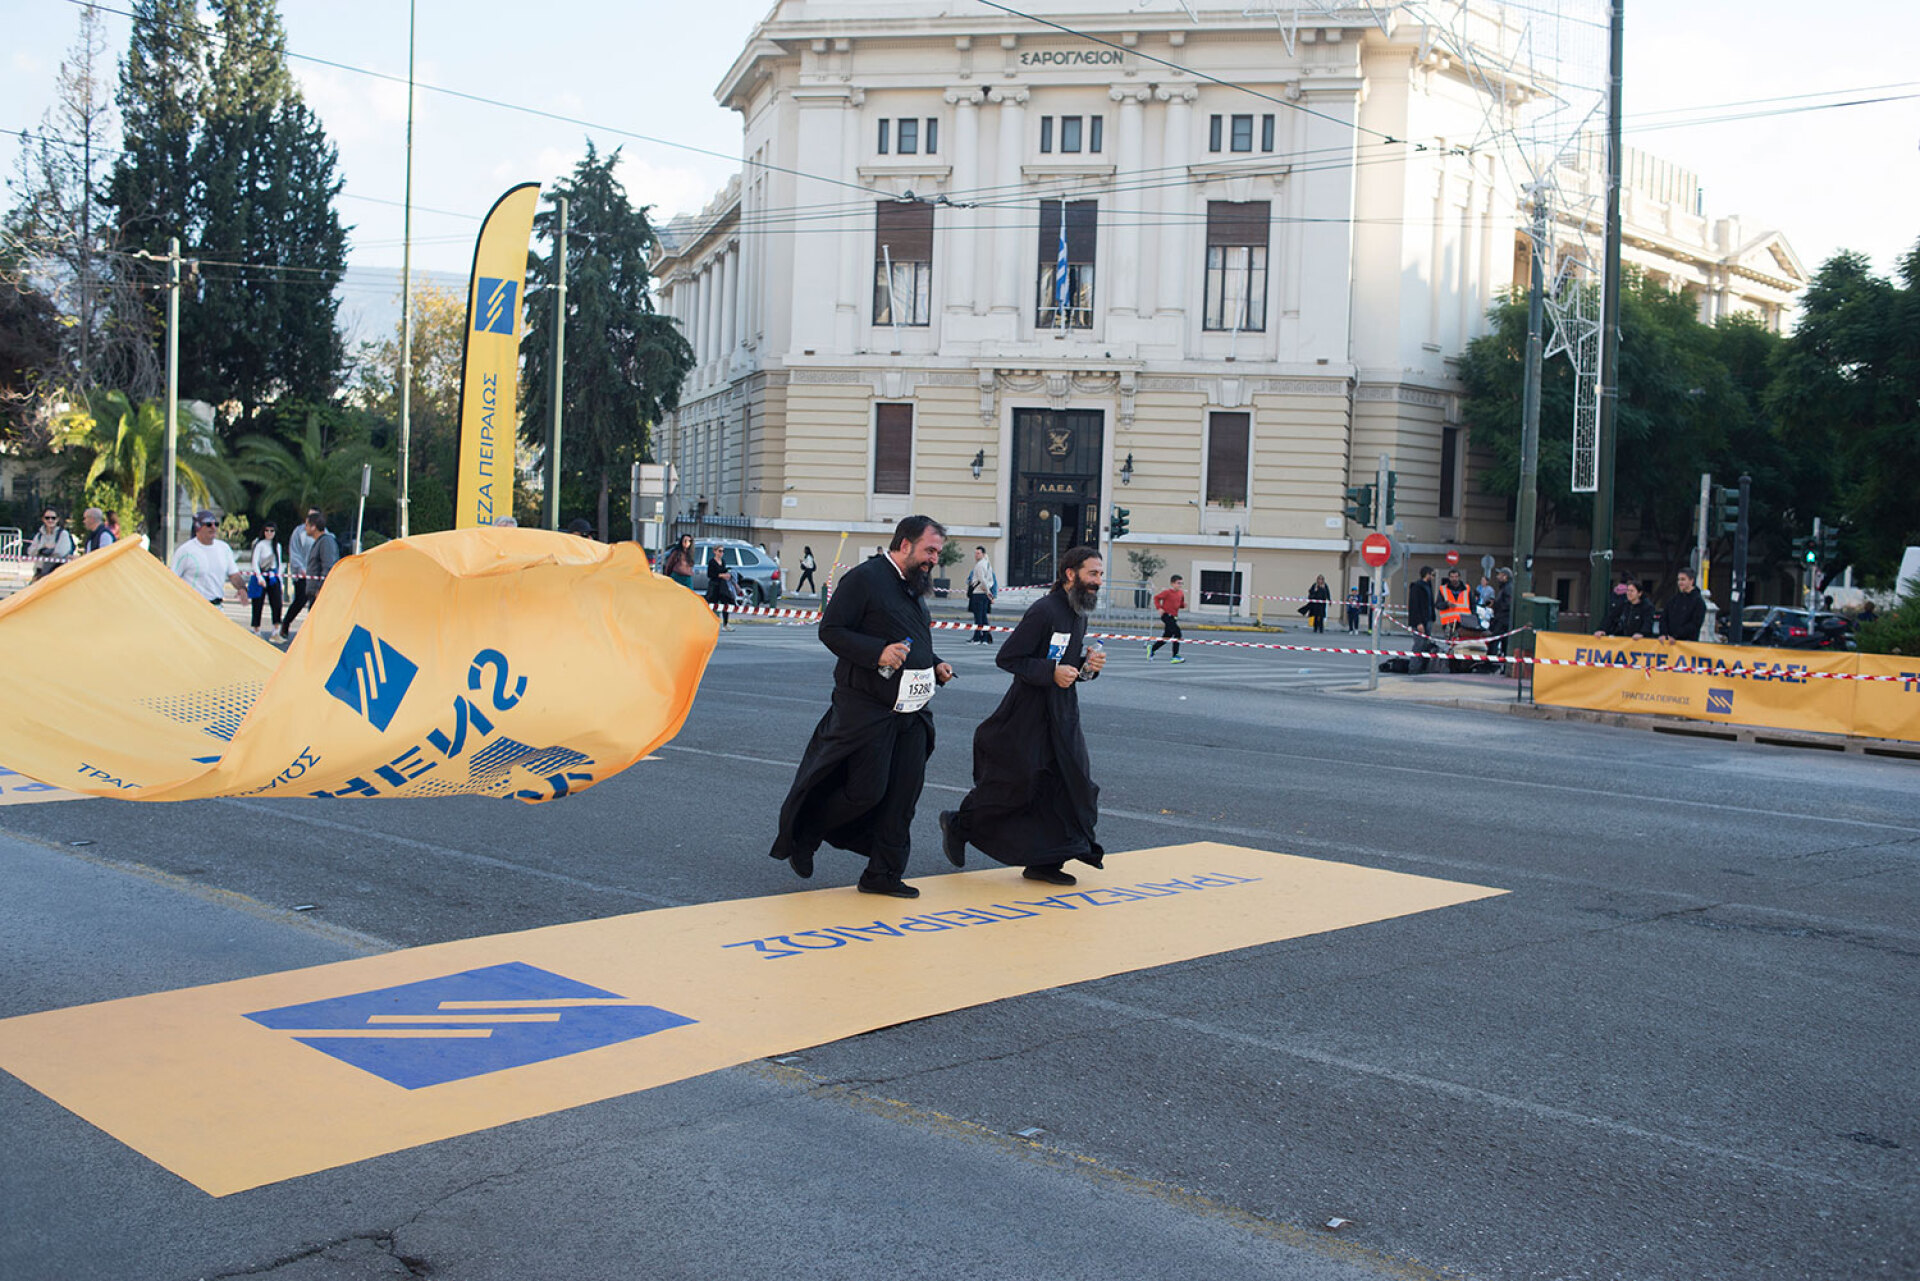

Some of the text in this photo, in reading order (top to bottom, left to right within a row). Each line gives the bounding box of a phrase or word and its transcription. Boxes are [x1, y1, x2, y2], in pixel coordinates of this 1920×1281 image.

[1020, 51, 1124, 65] ΣΑΡΟΓΛΕΙΟΝ
[480, 373, 497, 477] ΠΕΙΡΑΙΩΣ
[720, 872, 1264, 960] ΤΡΑΠΕΖΑ ΠΕΙΡΑΙΩΣ
